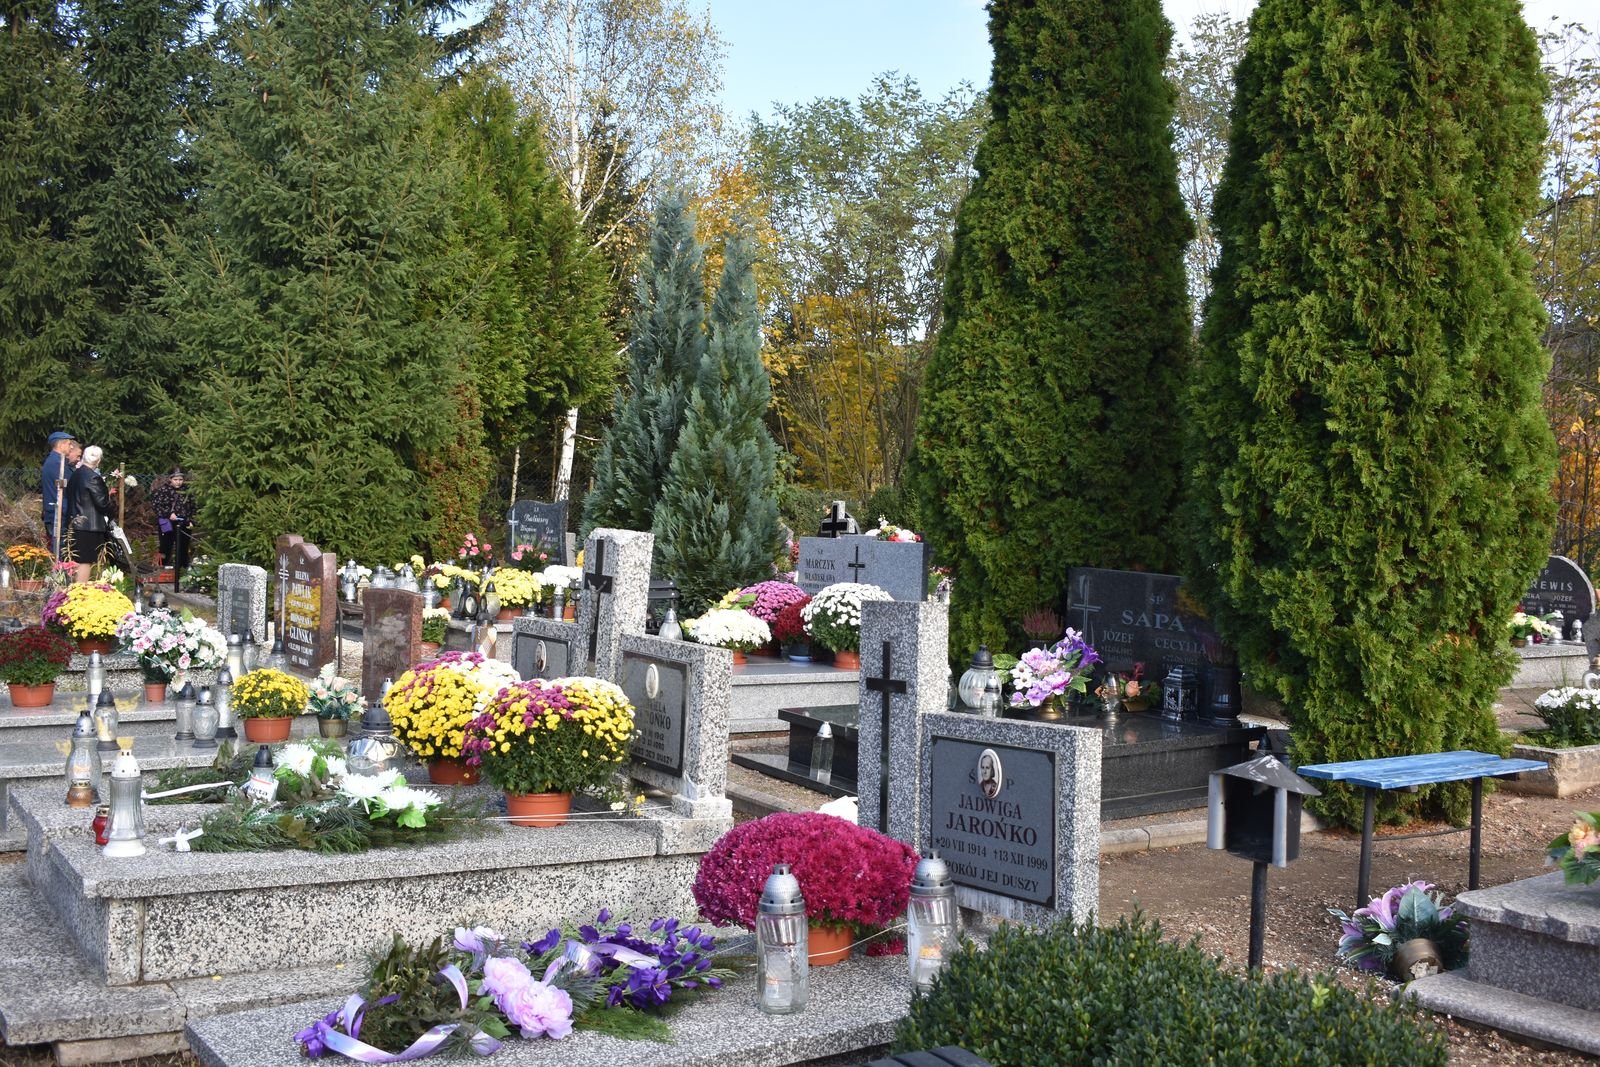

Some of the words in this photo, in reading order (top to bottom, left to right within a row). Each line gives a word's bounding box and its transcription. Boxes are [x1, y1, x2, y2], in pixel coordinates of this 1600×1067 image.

[805, 558, 836, 570] MARCZYK
[1121, 609, 1186, 633] SAPA
[1103, 629, 1135, 644] JÓZEF
[1154, 638, 1207, 655] CECYLIA
[1005, 778, 1015, 791] P
[958, 793, 1023, 821] JADWIGA
[945, 811, 1038, 848] JAROŃKO
[952, 839, 965, 852] VII
[967, 842, 987, 858] 1914
[1010, 852, 1025, 866] XII
[1027, 856, 1048, 871] 1999
[944, 858, 978, 878] POKÓJ
[980, 869, 999, 885] JEJ
[1002, 873, 1040, 893] DUSZY
